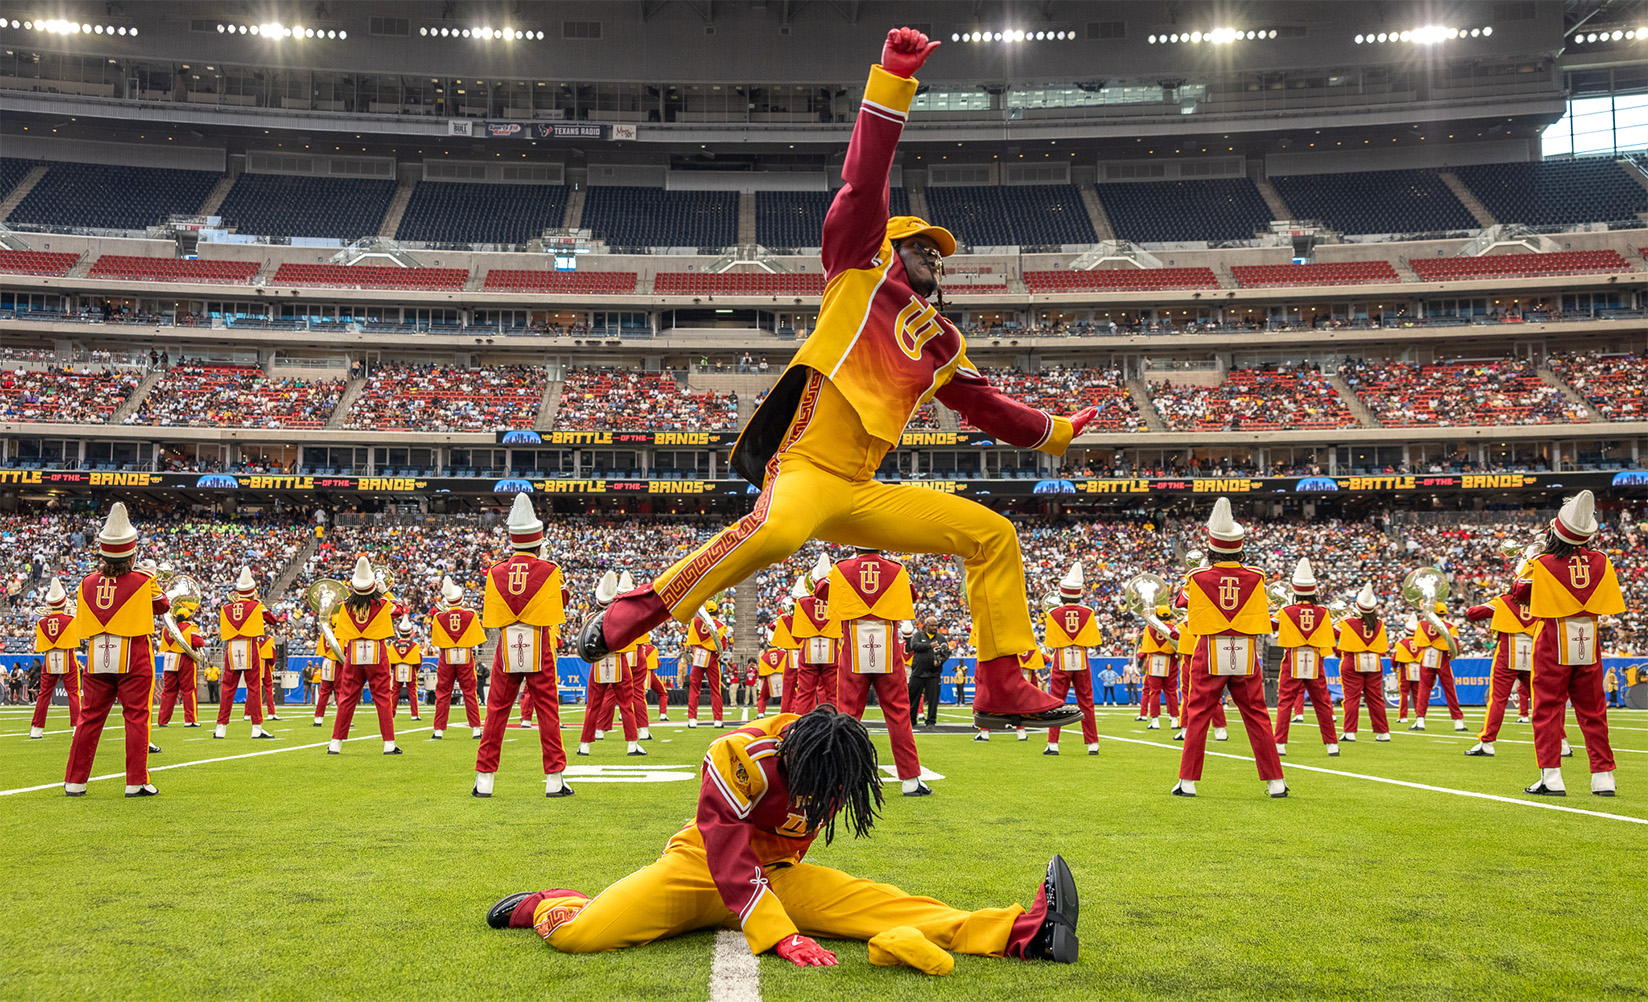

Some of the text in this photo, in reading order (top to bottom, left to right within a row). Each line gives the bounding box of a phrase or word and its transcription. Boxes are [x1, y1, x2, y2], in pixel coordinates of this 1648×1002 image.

[554, 127, 600, 135] TEXANS RADIO
[552, 431, 613, 444] BATTLE
[654, 432, 709, 445] BANDS
[902, 432, 957, 445] BANDS
[0, 470, 42, 484] TTLE
[89, 472, 150, 486] BANDS
[250, 475, 314, 489] BATTLE
[358, 478, 416, 491] BANDS
[544, 480, 606, 493] BATTLE
[648, 481, 704, 493] BANDS
[1086, 480, 1149, 493] BATTLE
[1193, 479, 1251, 492] BANDS
[1349, 476, 1416, 490] BATTLE
[1423, 478, 1434, 486] OF
[1461, 474, 1524, 488] BANDS
[508, 563, 529, 595] TU
[859, 561, 880, 594] TU
[1568, 556, 1590, 589] TU
[95, 575, 117, 610] TU
[1218, 576, 1239, 611] TU
[232, 603, 244, 621] TU
[1299, 608, 1315, 632] TU
[47, 617, 60, 636] TU
[449, 613, 461, 632] TU
[1064, 610, 1080, 633] TU
[567, 675, 579, 684] TX
[1455, 677, 1490, 685] HOUST
